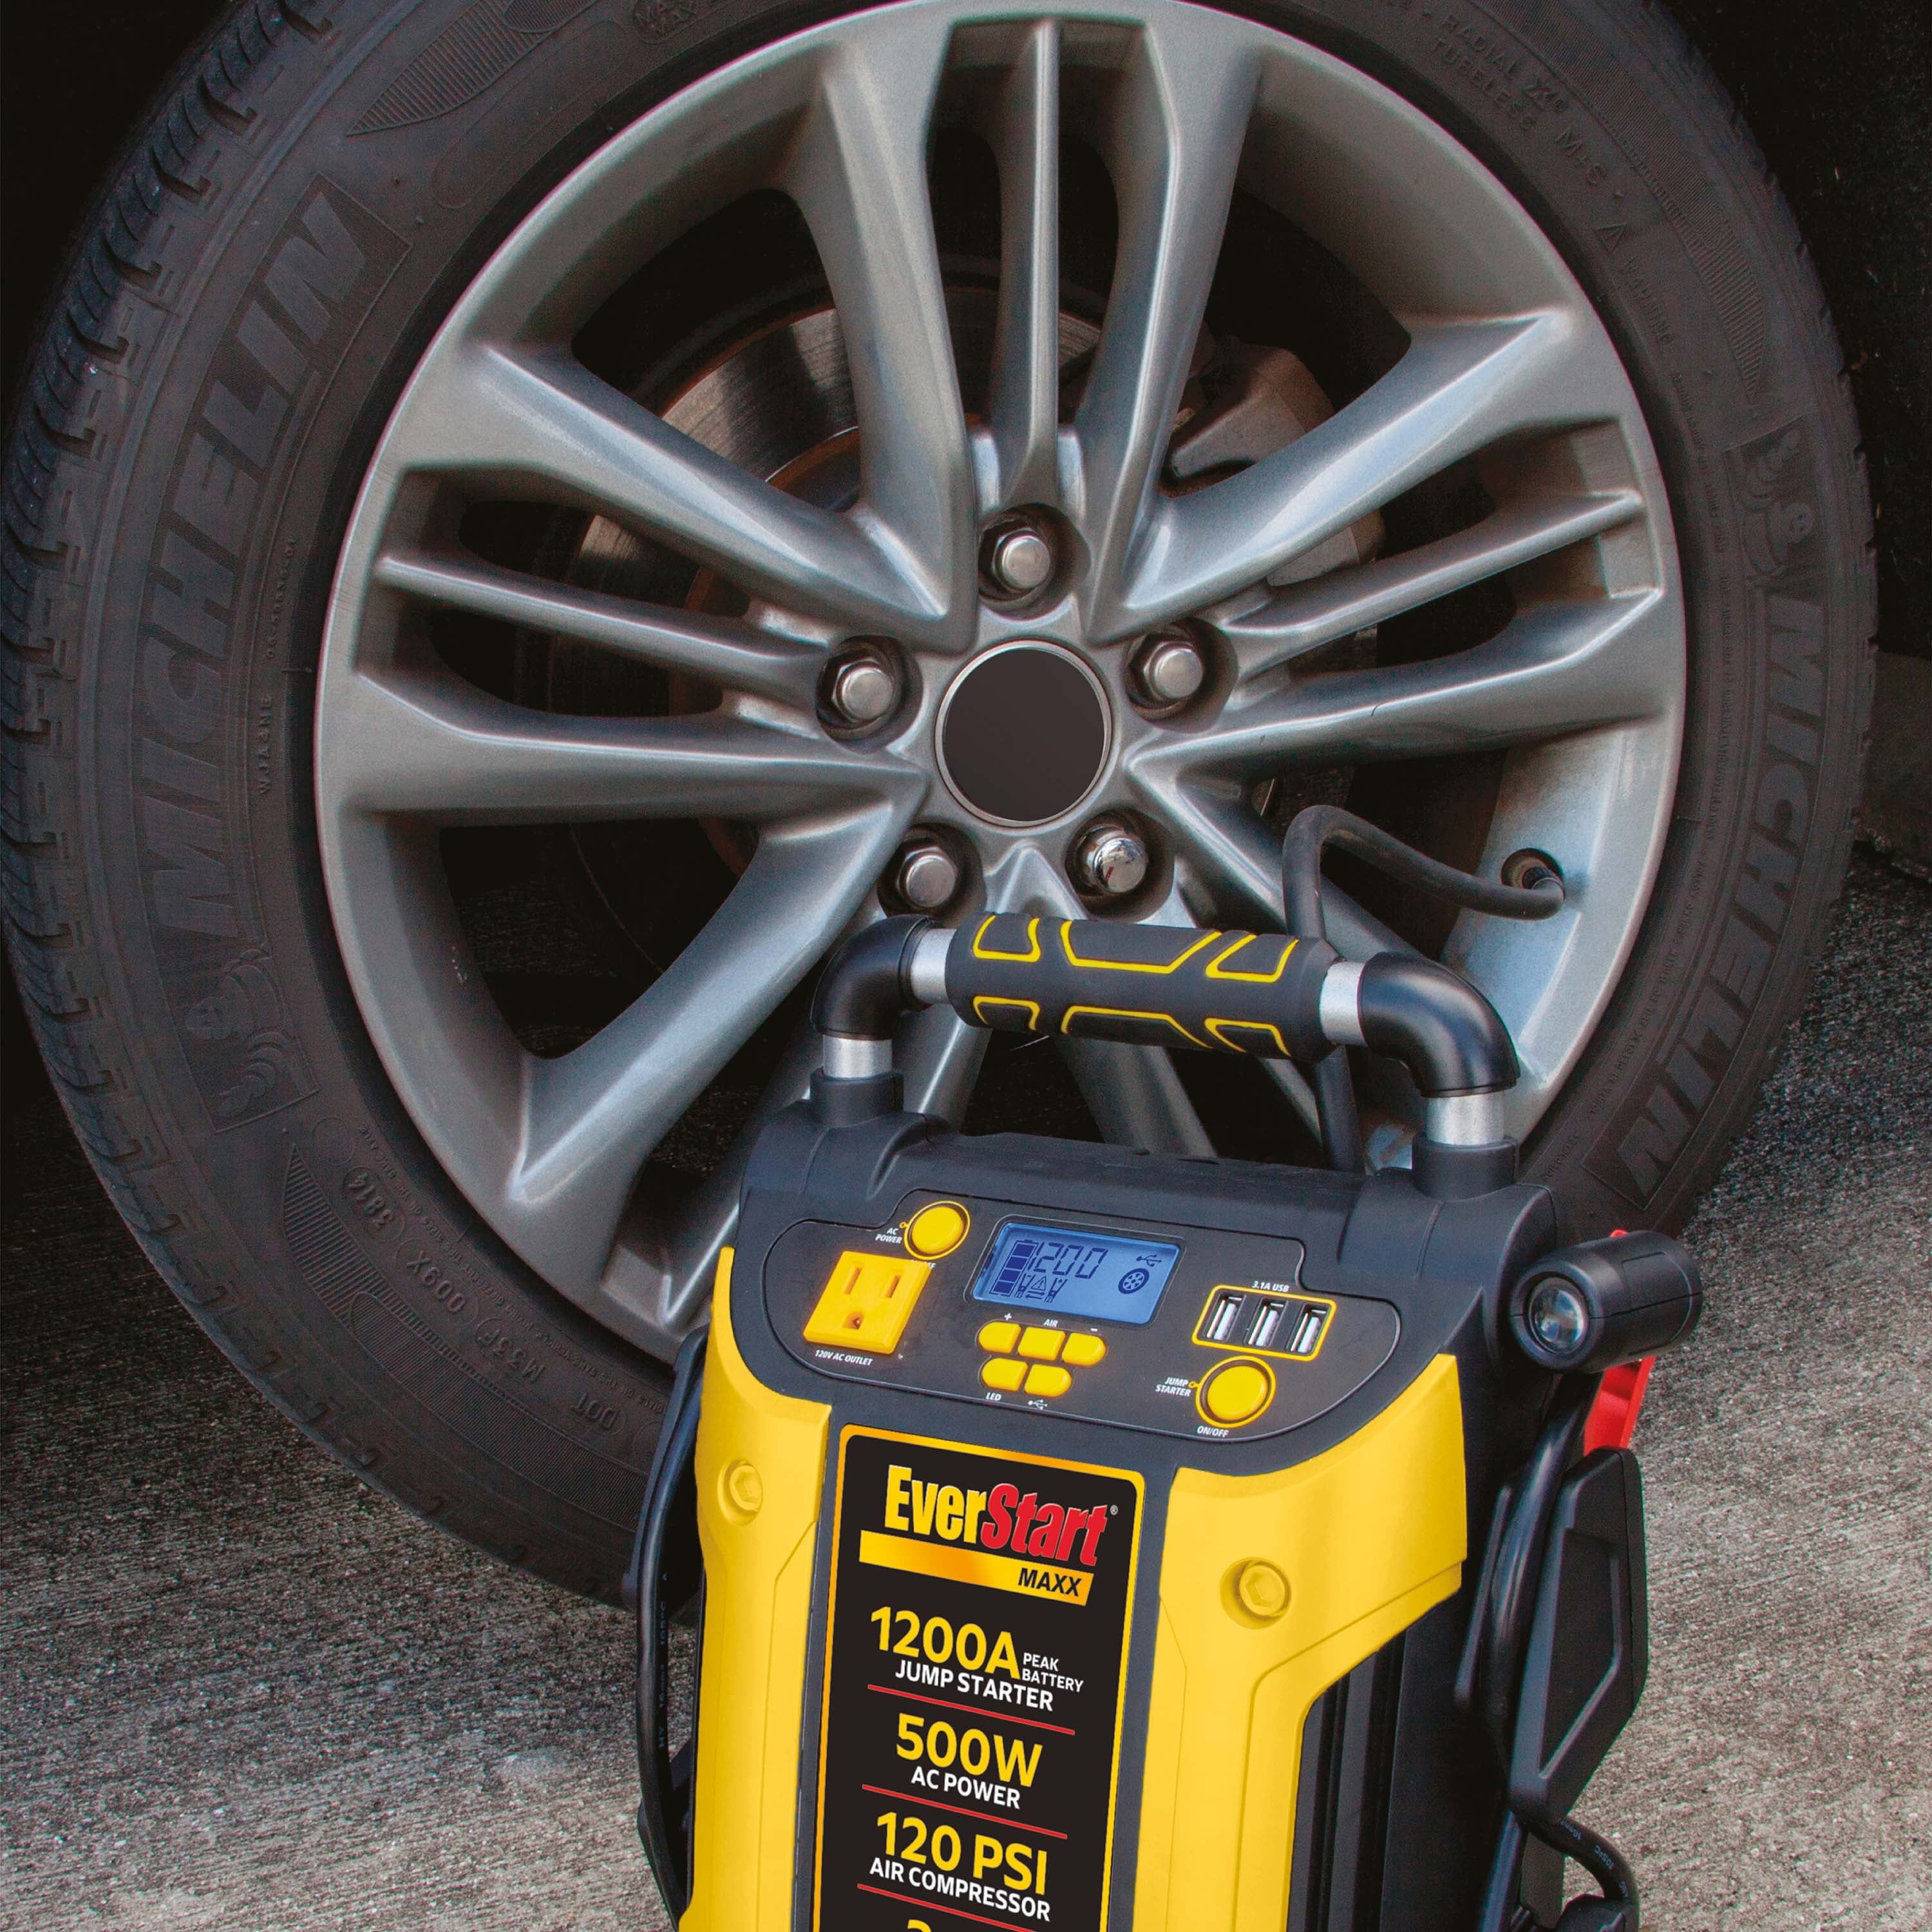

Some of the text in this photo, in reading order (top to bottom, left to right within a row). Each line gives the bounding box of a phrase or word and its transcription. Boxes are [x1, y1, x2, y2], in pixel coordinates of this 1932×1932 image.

[141, 191, 366, 938] MICHELIN
[1616, 594, 1825, 1198] MICHELIN
[346, 1171, 395, 1230] 3814
[875, 1233, 902, 1244] POWER
[1027, 1242, 1108, 1279] 1200
[1252, 1280, 1289, 1293] 3.1A USB
[1043, 1319, 1059, 1327] AIR
[815, 1349, 873, 1365] 120V AC OUTLET
[985, 1392, 1002, 1401] LED
[1155, 1385, 1191, 1397] STARTER
[1164, 1377, 1189, 1387] JUMP
[570, 1392, 619, 1432] DOT
[1197, 1425, 1229, 1438] ON/OFF
[1017, 1567, 1083, 1597] MAXX
[870, 1606, 1021, 1679] 1200A
[1022, 1653, 1059, 1672] PEAK
[895, 1659, 1054, 1712] JUMP STARTER
[1021, 1668, 1084, 1693] BATTERY
[896, 1713, 1043, 1787] 500W
[911, 1766, 1021, 1809] AC POWER
[876, 1812, 1048, 1895] 120 PSI
[869, 1857, 1050, 1922] AIR COMPRESSOR
